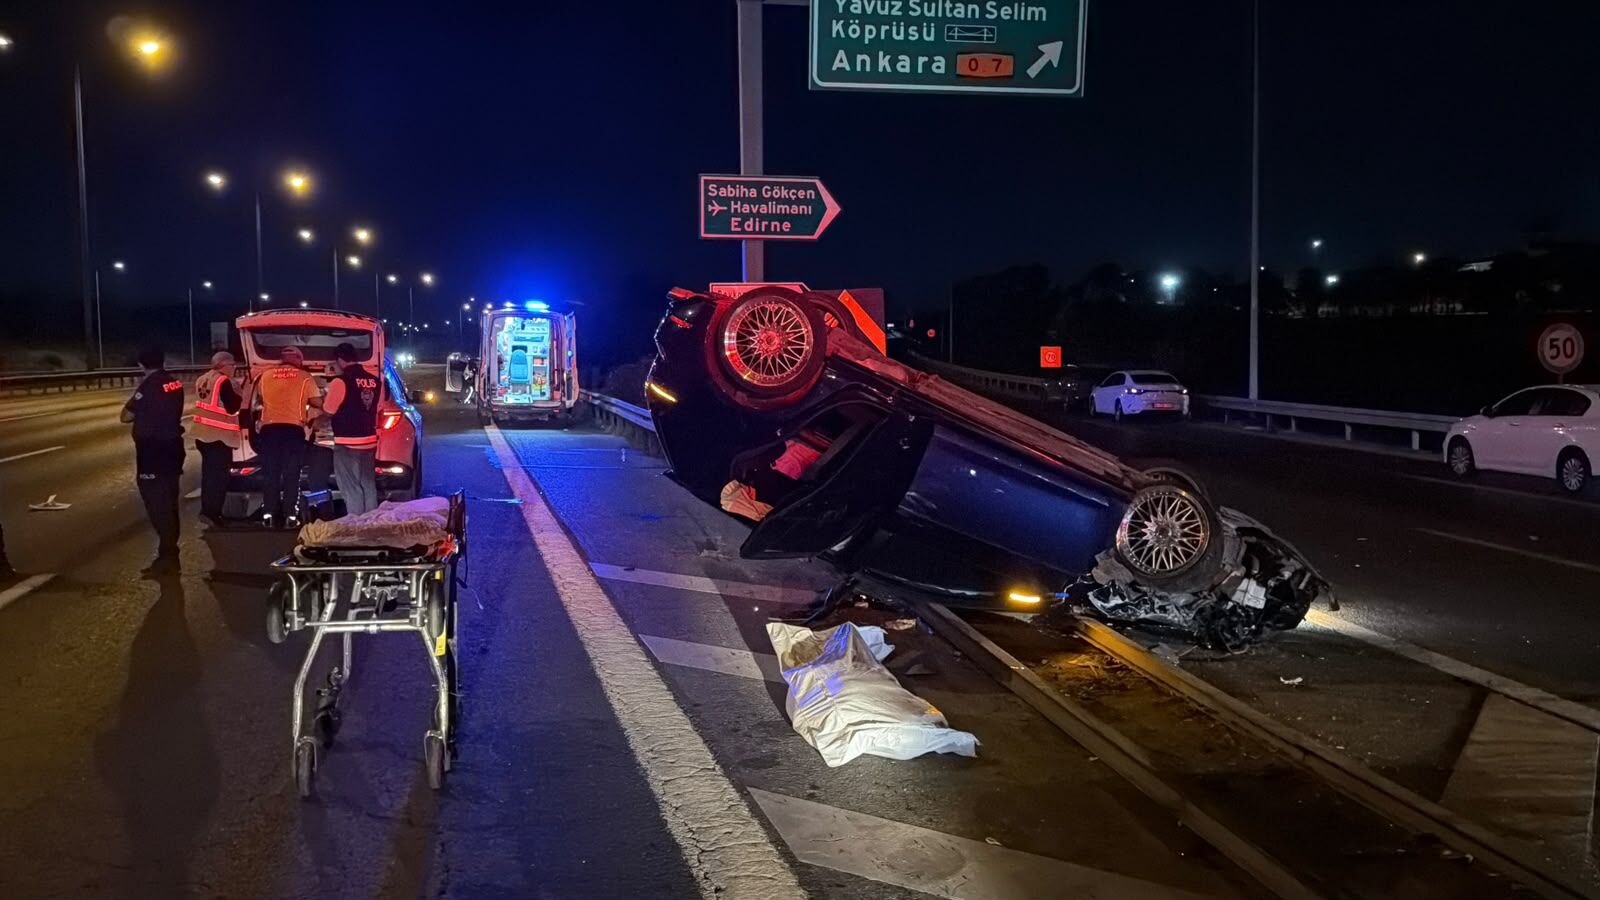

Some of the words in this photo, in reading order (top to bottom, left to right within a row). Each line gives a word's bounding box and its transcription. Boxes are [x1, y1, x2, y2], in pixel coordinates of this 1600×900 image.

[836, 0, 903, 16] Yavuz
[908, 0, 980, 19] Sultan
[985, 1, 1047, 21] Selim
[831, 19, 936, 44] Köprüsü
[831, 49, 946, 74] Ankara
[708, 184, 757, 198] Sabiha
[762, 185, 815, 200] Gökçen
[730, 200, 812, 215] Havalimanı
[730, 217, 792, 232] Edirne
[1549, 337, 1575, 360] 50
